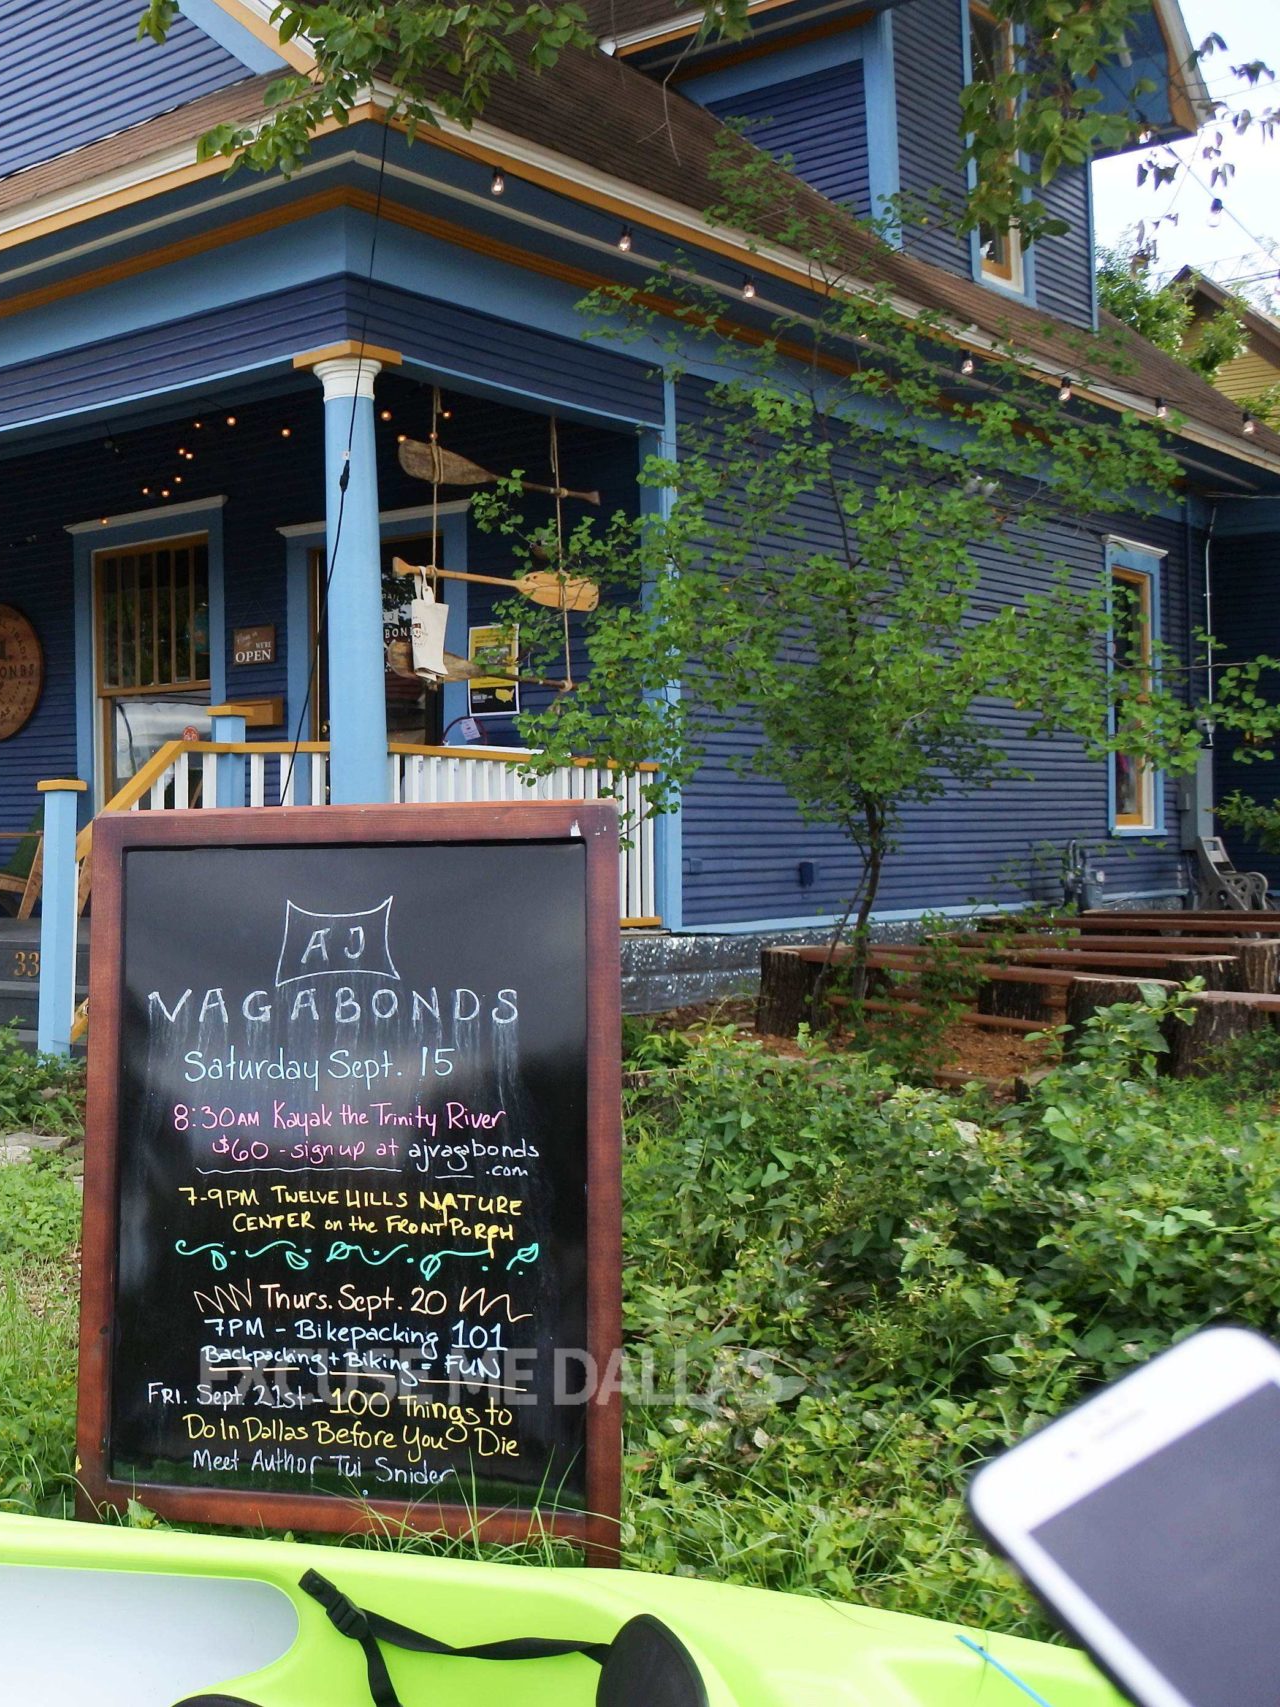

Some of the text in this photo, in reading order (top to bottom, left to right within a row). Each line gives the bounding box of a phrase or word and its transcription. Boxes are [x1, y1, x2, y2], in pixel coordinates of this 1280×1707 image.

[235, 649, 271, 663] OPEN
[301, 926, 366, 964] AJ
[147, 987, 519, 1024] VAGABONDS
[184, 1045, 456, 1091] Saturday Sept. 15
[173, 1100, 506, 1137] 8:30AM Kayak the Trinity River
[212, 1134, 269, 1162] $60
[376, 1138, 400, 1157] at
[408, 1138, 540, 1173] ajvagabonds
[485, 1165, 529, 1177] .com
[178, 1185, 523, 1216] 7-9PM TWELVE HILLS NATURE
[232, 1211, 316, 1232] CENTER
[324, 1219, 343, 1231] on
[349, 1215, 378, 1233] the
[386, 1215, 444, 1236] FRONT
[259, 1283, 447, 1321] Thurs. Sept. 20
[204, 1317, 265, 1338] 7PM
[294, 1319, 439, 1360] Bikepacking
[451, 1319, 508, 1351] 101
[200, 1345, 328, 1376] Backpacking
[343, 1350, 418, 1387] Biking
[444, 1354, 501, 1379] FUN
[148, 1382, 187, 1404] FRI.
[196, 1384, 245, 1411] Sept.
[329, 1387, 390, 1418] 100
[397, 1395, 481, 1443] Things
[484, 1396, 513, 1426] to
[182, 1413, 216, 1439] Do
[242, 1416, 309, 1443] Dallas
[312, 1420, 397, 1449] Before
[402, 1425, 449, 1463] You
[473, 1427, 520, 1457] Die
[193, 1447, 456, 1485] Meet Author Tui Snider
